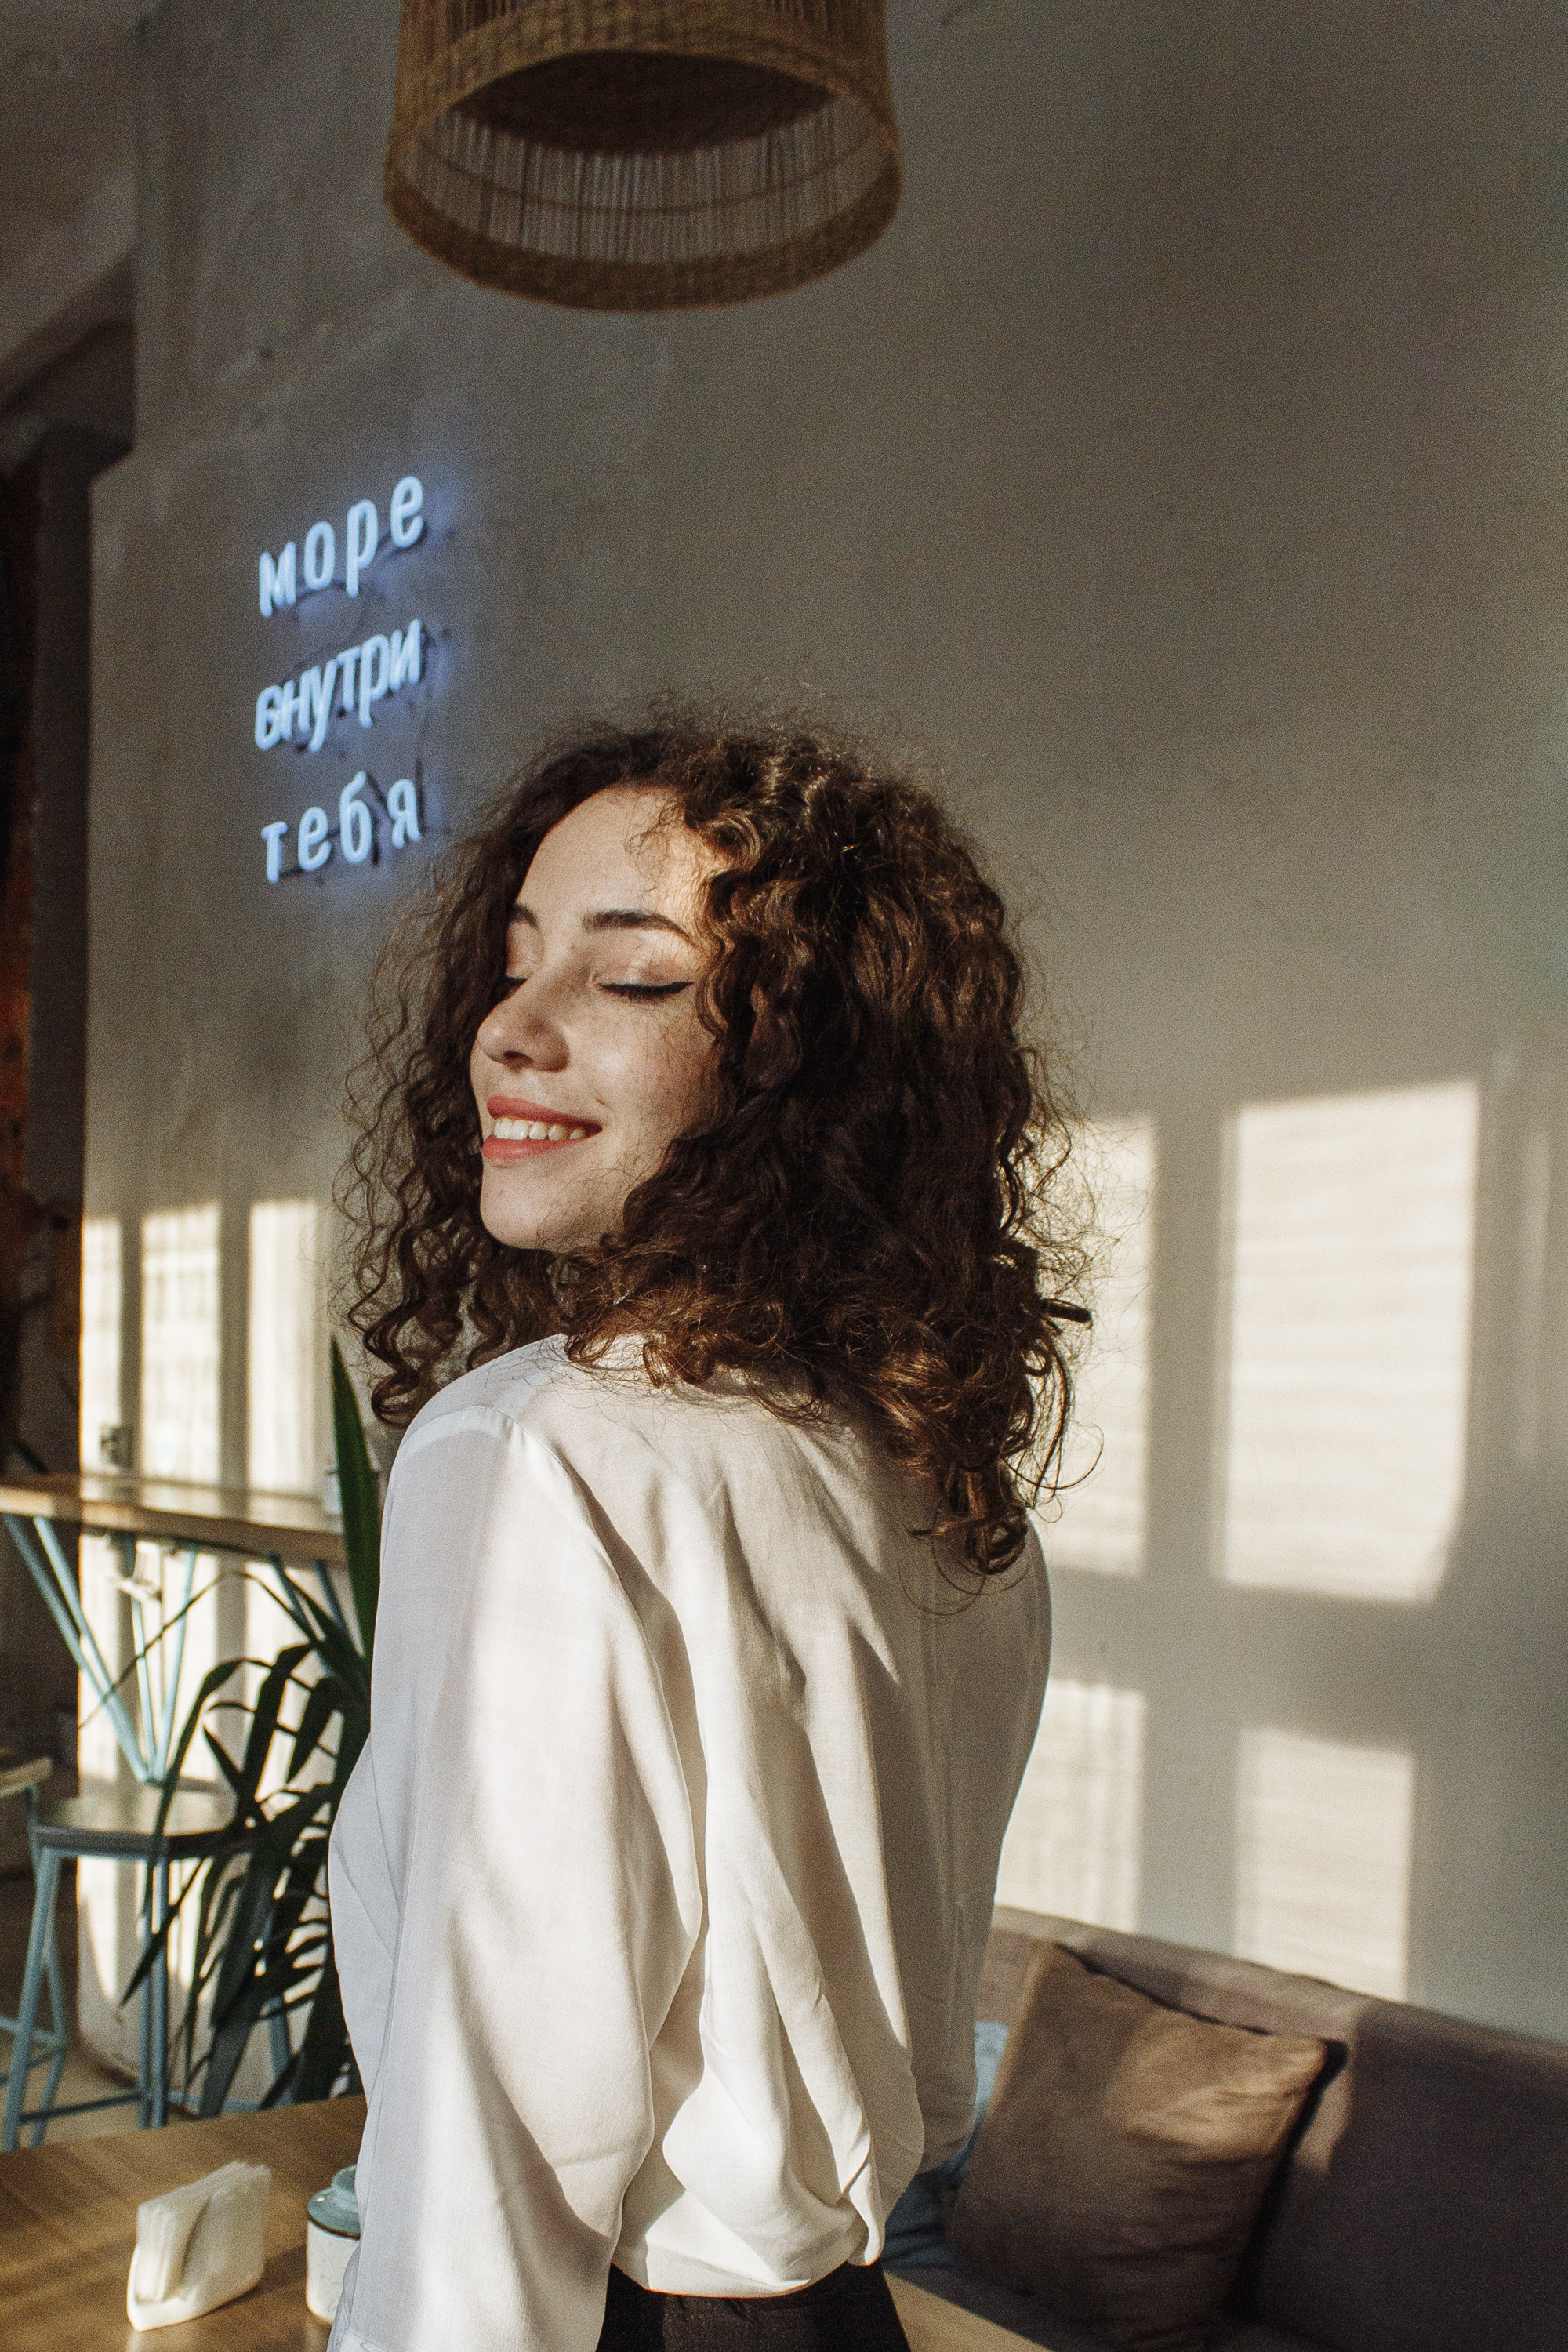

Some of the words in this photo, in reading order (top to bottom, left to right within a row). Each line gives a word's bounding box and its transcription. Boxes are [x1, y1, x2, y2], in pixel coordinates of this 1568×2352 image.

[260, 475, 424, 617] море
[255, 619, 423, 752] внутри
[261, 771, 422, 883] тебя
